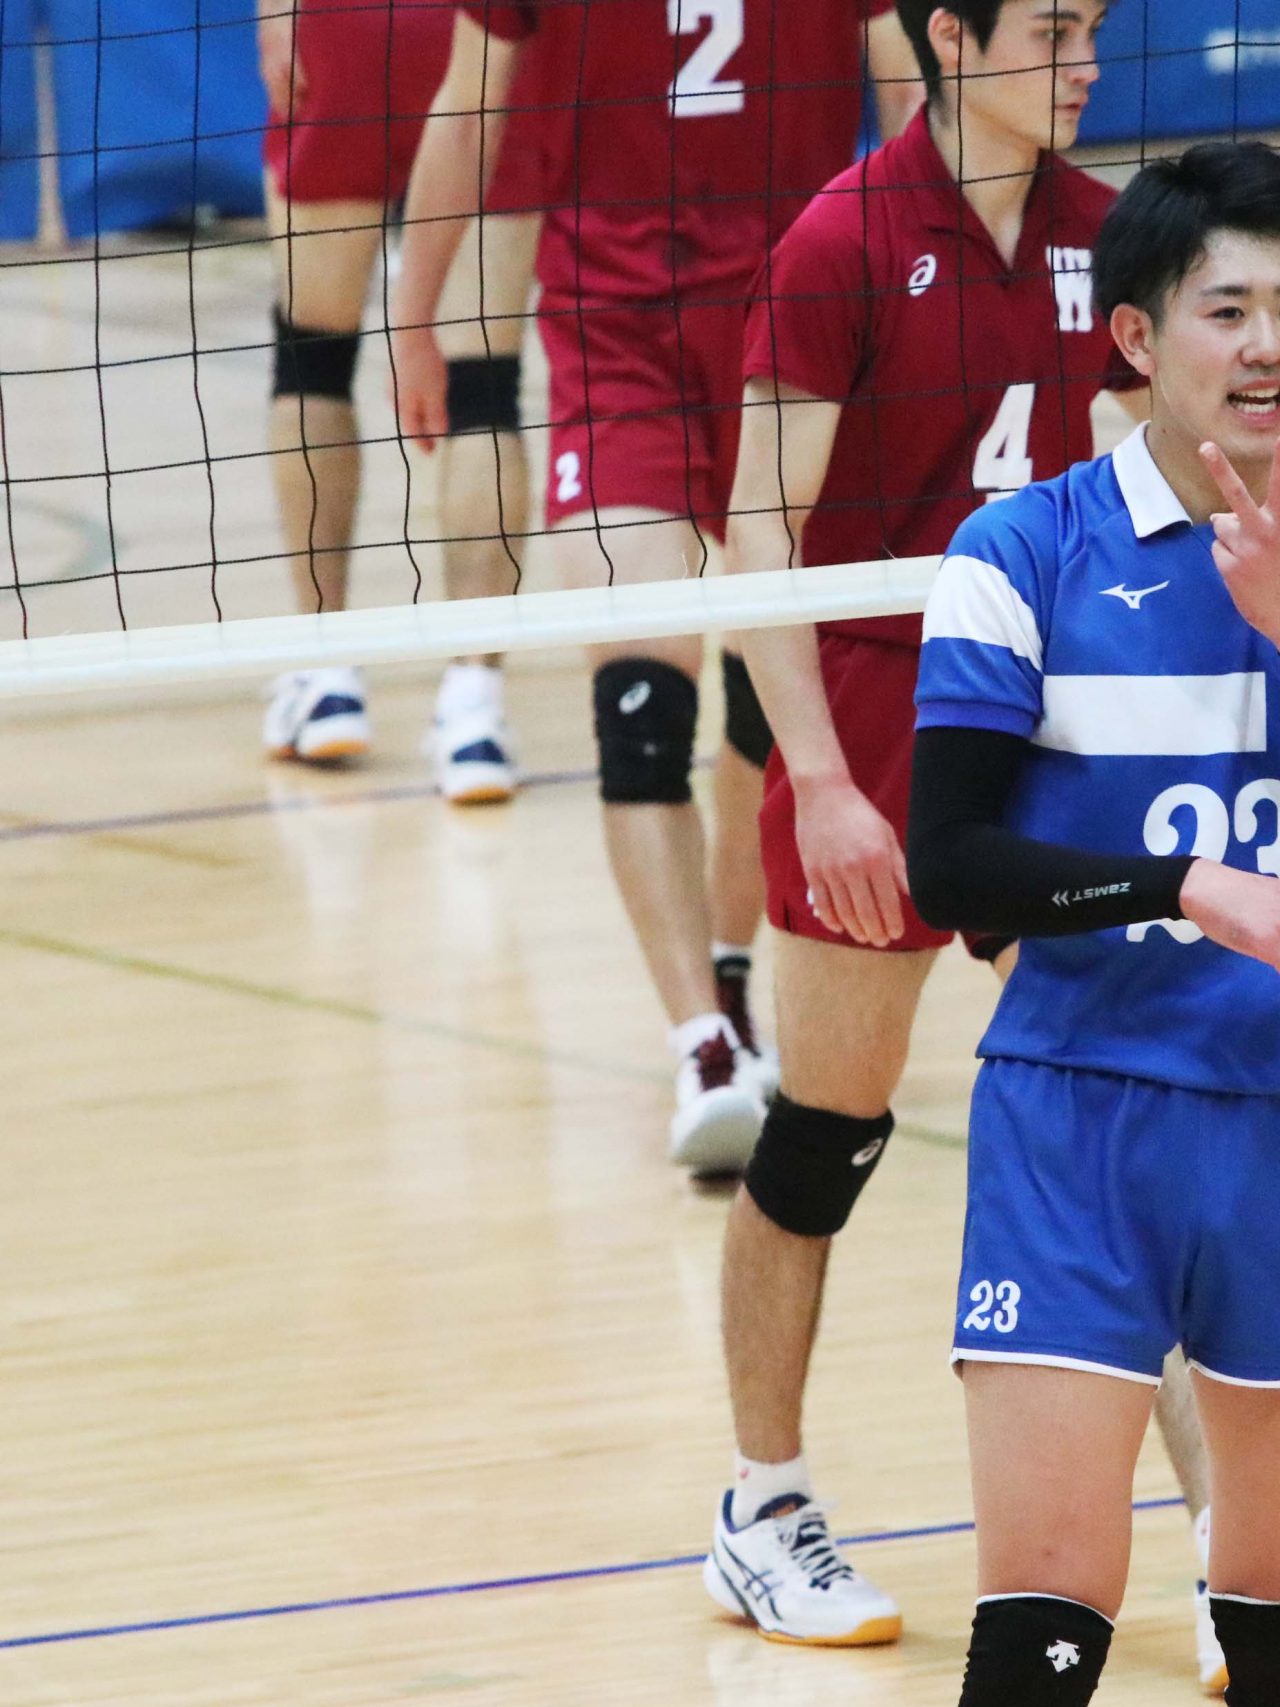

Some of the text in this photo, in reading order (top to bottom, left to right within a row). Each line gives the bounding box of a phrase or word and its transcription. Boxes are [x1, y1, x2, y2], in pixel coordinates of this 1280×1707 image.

[666, 0, 744, 118] 2
[555, 450, 582, 503] 2
[972, 382, 1036, 503] 4
[963, 1280, 1021, 1333] 23
